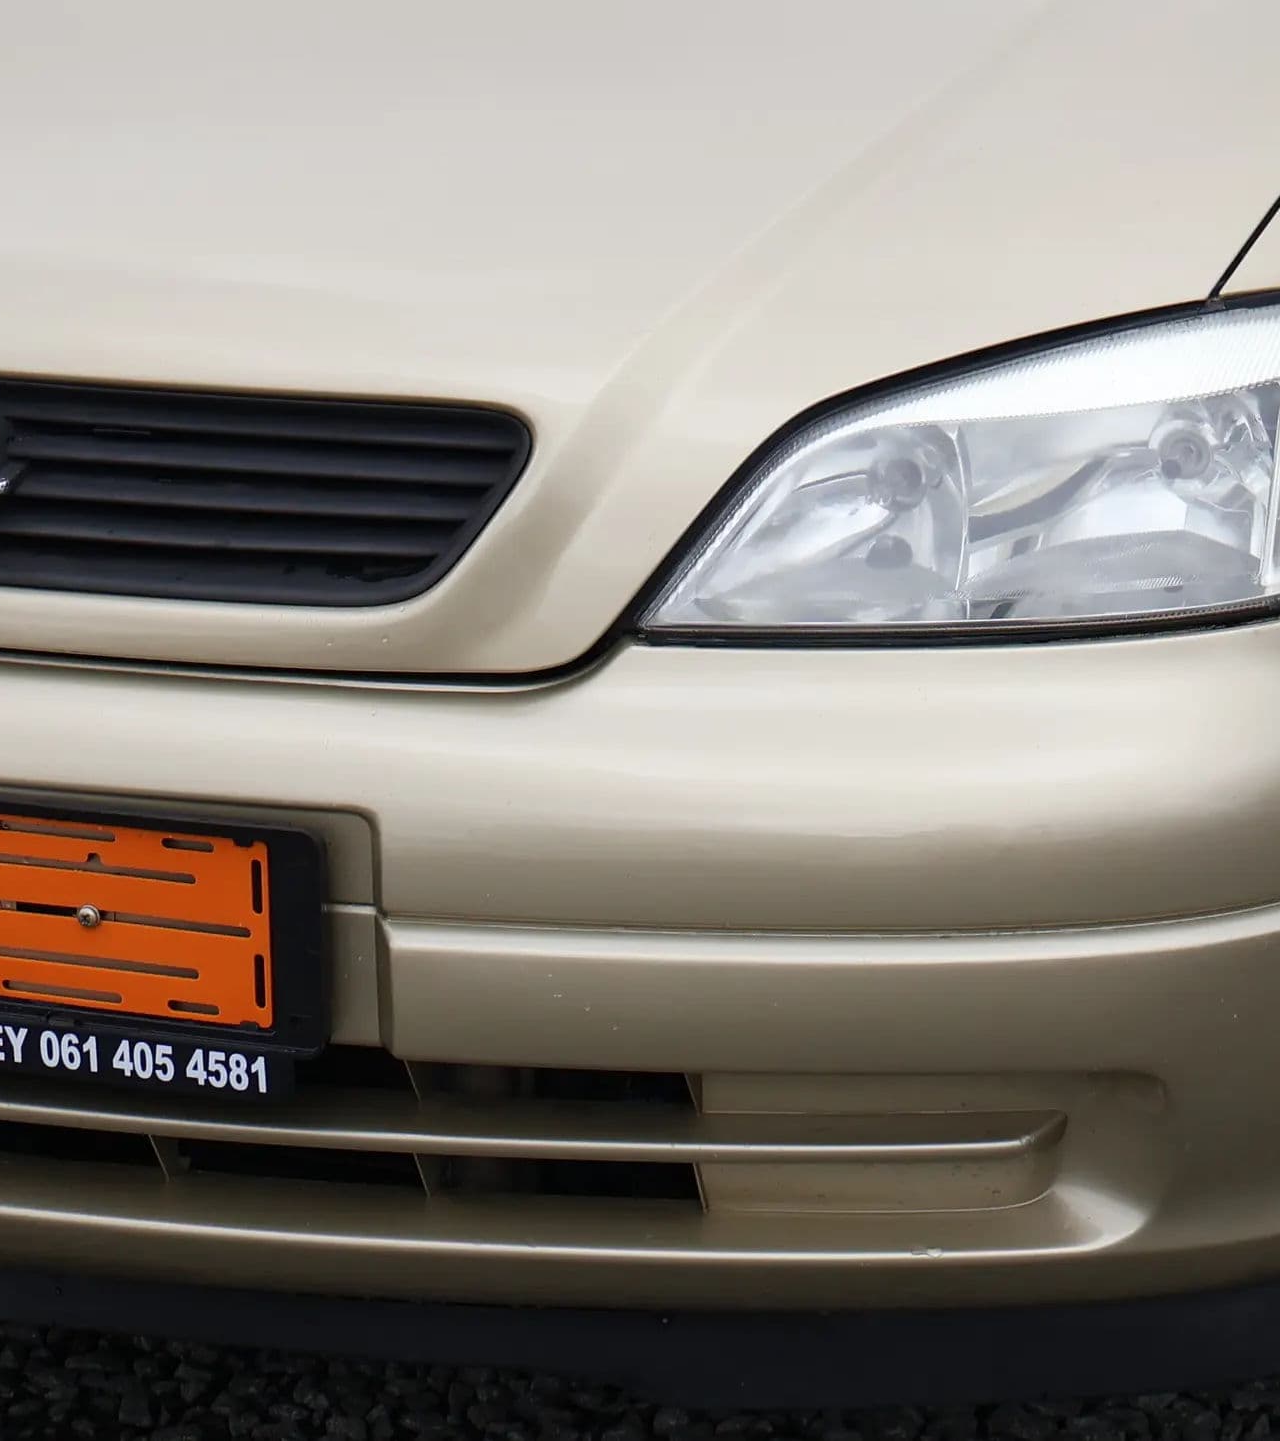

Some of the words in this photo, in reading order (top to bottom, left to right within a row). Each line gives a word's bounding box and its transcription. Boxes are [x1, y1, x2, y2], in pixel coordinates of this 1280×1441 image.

[38, 1030, 98, 1073] 061
[112, 1039, 175, 1082] 405
[185, 1048, 268, 1094] 4581
